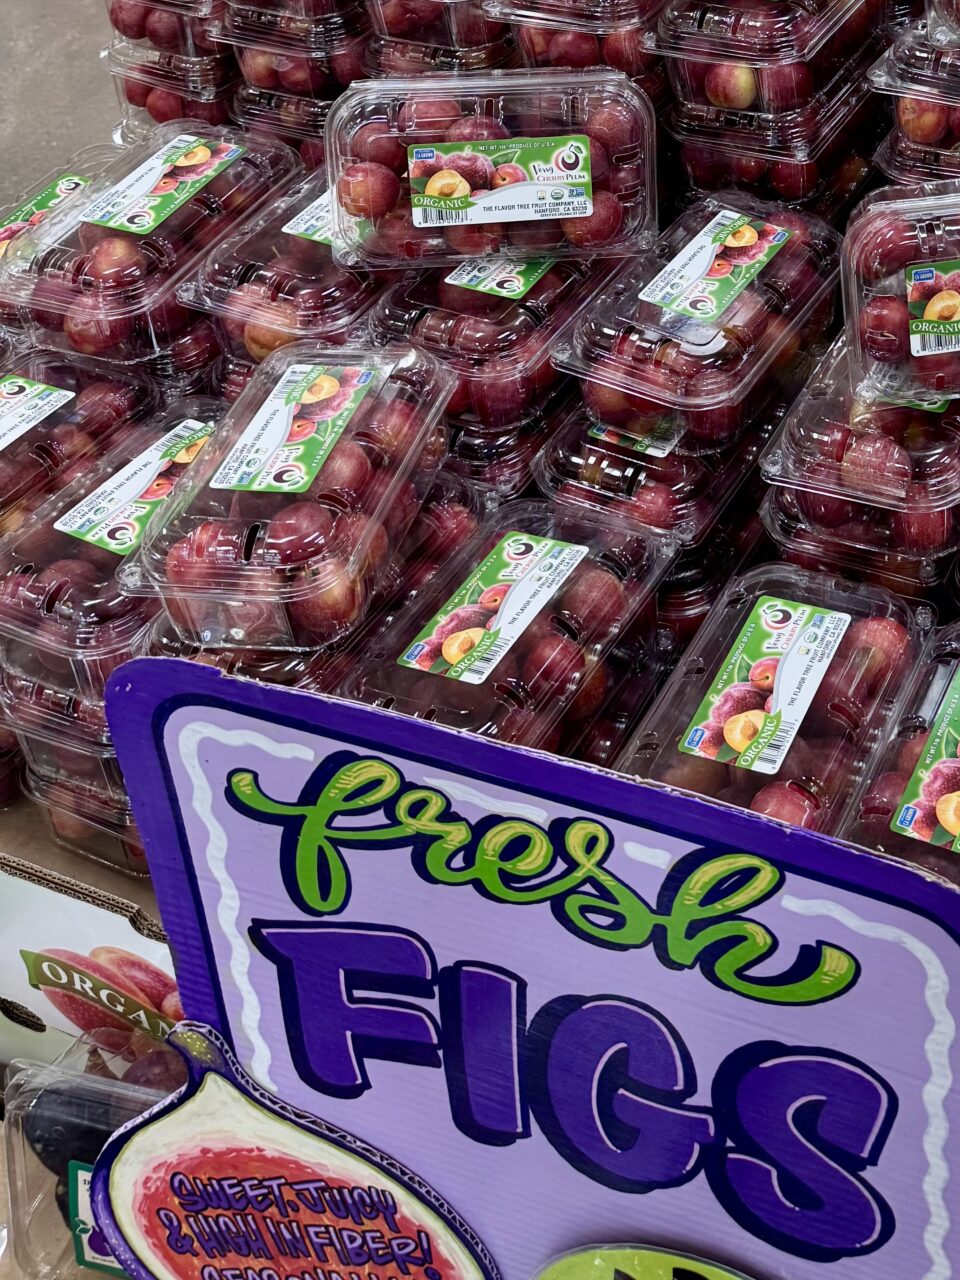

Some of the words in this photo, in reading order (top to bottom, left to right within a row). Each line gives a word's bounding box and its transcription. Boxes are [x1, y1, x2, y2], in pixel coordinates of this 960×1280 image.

[414, 196, 466, 208] ORGANIC
[716, 217, 748, 241] ORGANIC
[290, 367, 323, 399] ORGANIC
[166, 427, 210, 456] ORGANIC
[449, 634, 494, 675] ORGANIC
[739, 717, 776, 765] ORGANIC
[249, 919, 899, 1261] FIGS
[296, 1179, 399, 1233] JUICY
[157, 1207, 199, 1257] &
[186, 1214, 273, 1260] HIGH
[266, 1217, 305, 1260] IN
[305, 1225, 442, 1279] FIBER!
